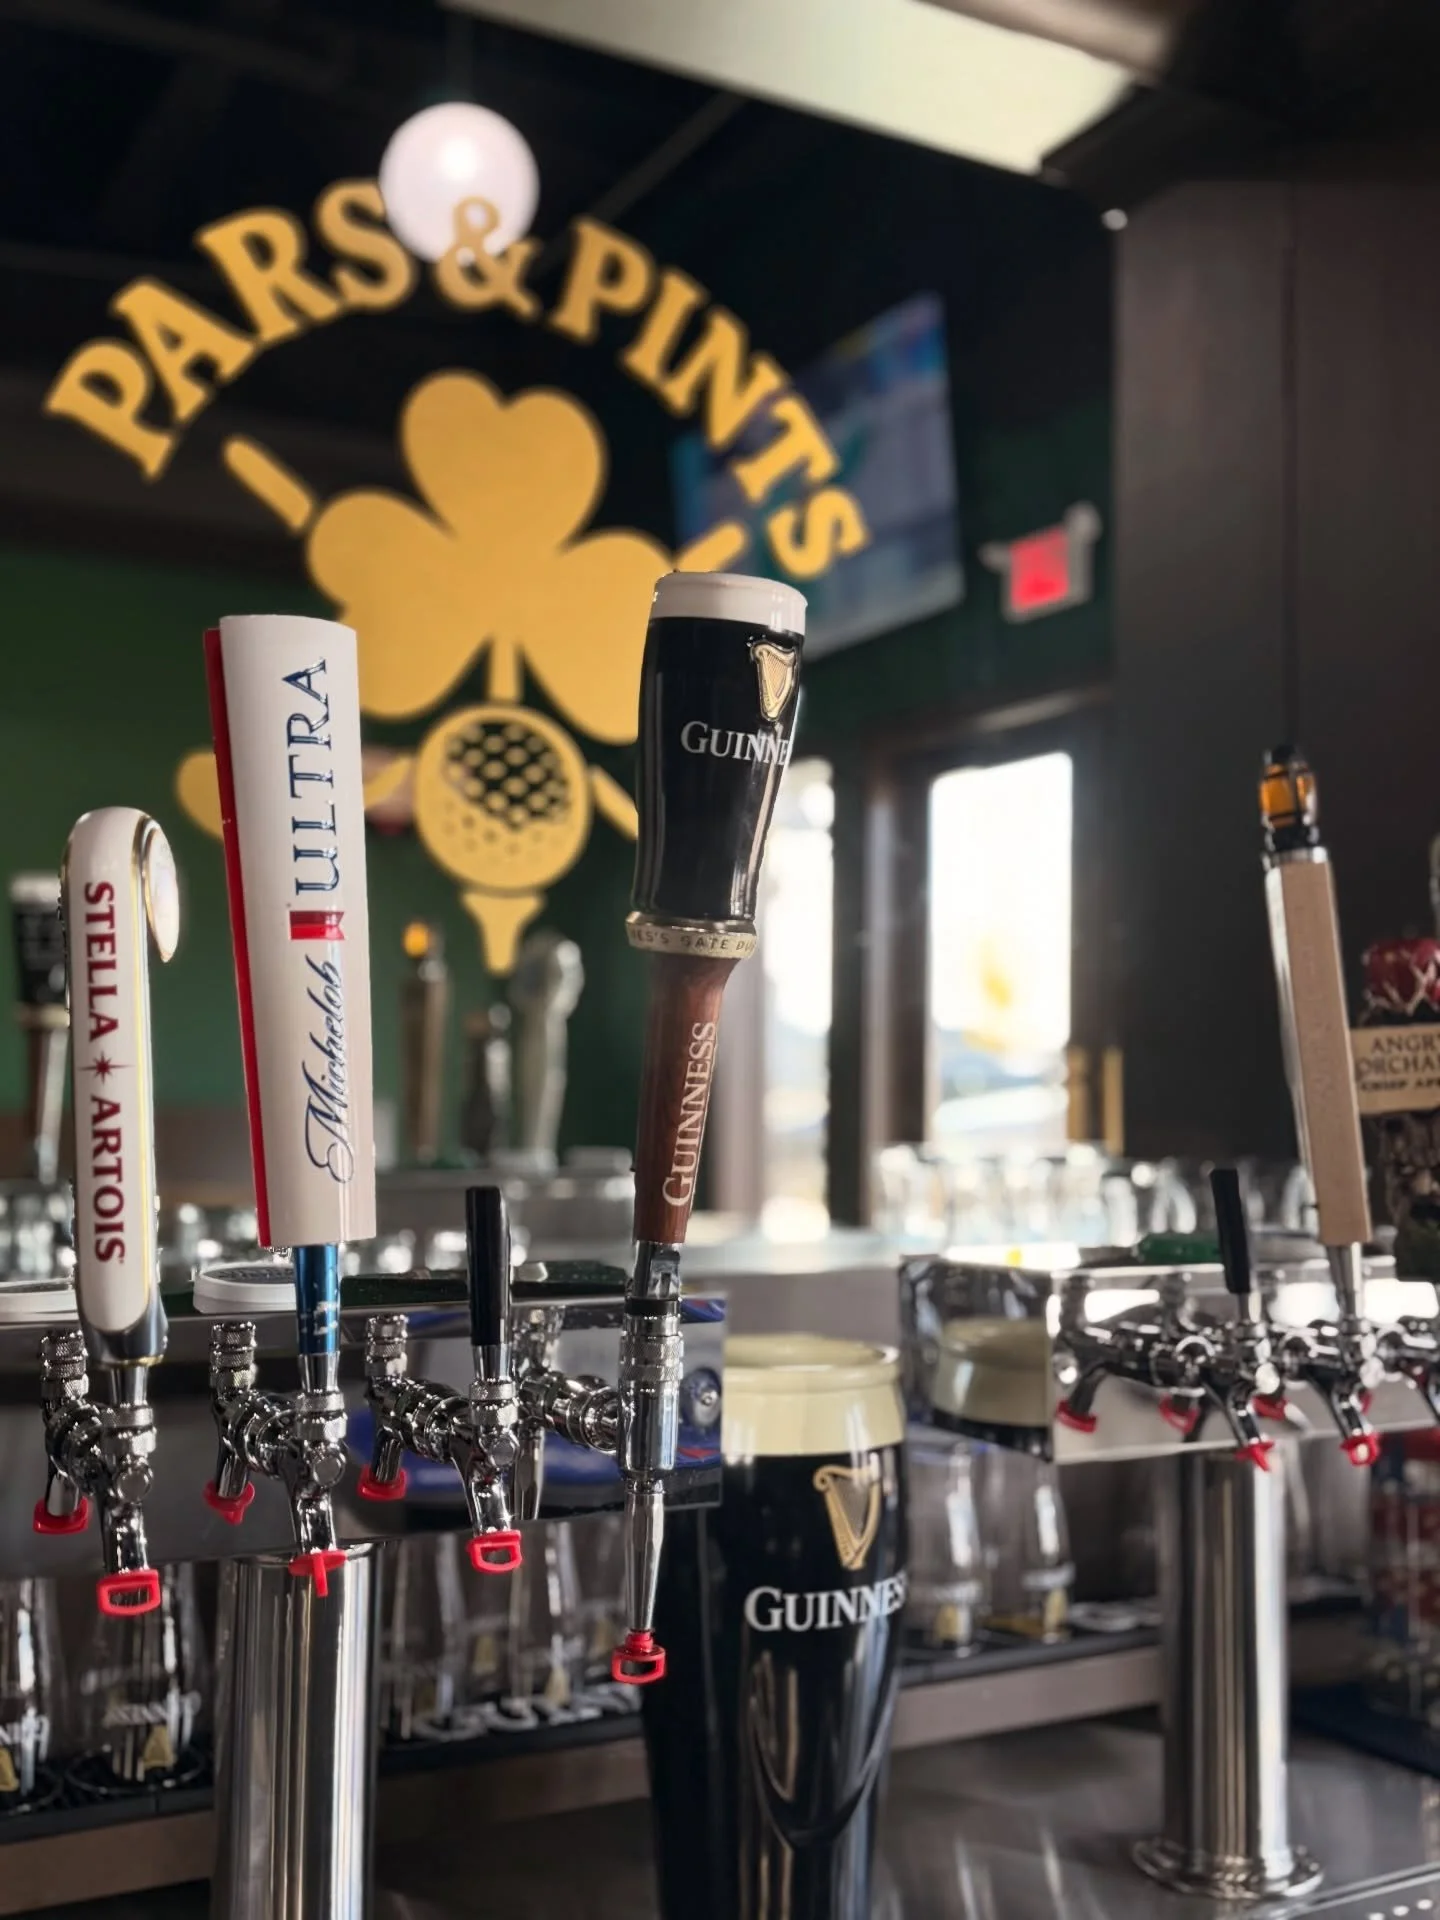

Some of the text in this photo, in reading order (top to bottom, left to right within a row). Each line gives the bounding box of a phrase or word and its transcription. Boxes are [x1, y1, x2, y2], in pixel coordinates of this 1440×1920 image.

[45, 178, 869, 578] PARS & PINTS
[282, 657, 341, 896] ULTRA
[82, 881, 125, 1263] STELLA ARTOIS
[302, 954, 355, 1184] Michelob
[663, 1021, 717, 1206] GUINNESS
